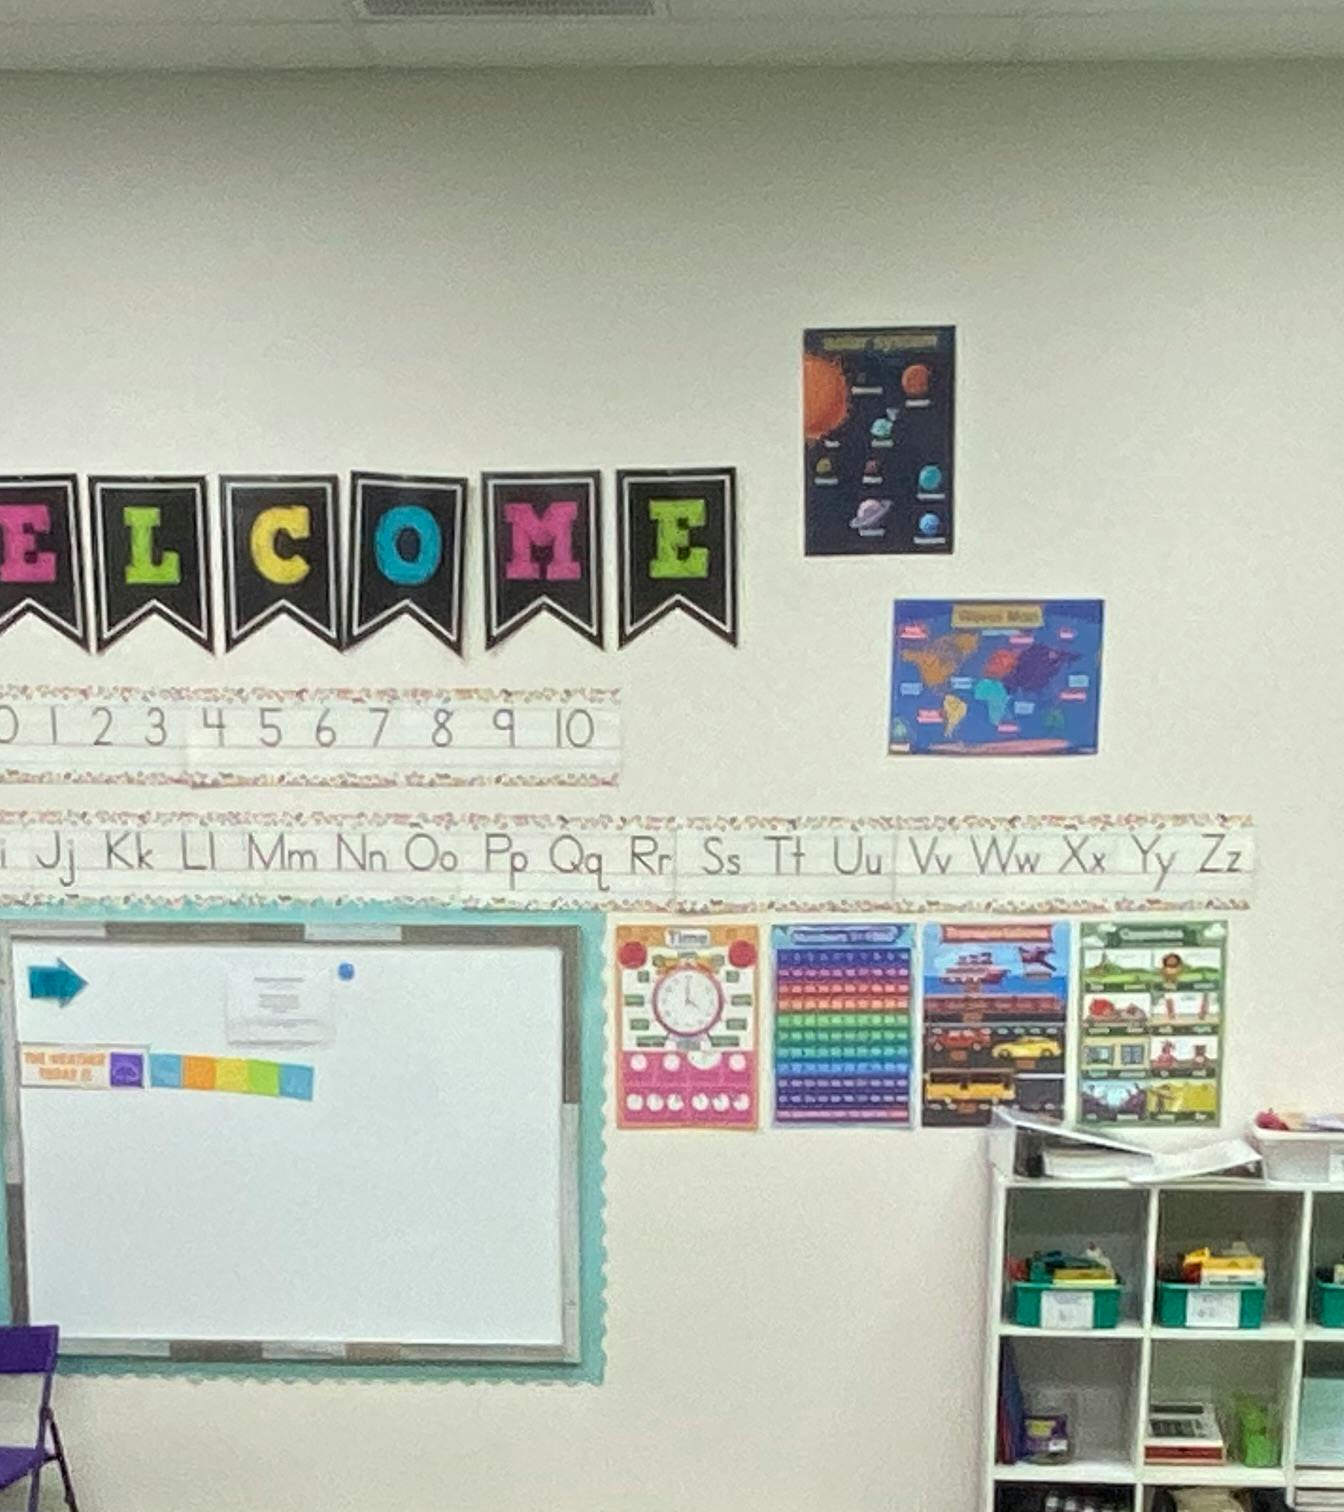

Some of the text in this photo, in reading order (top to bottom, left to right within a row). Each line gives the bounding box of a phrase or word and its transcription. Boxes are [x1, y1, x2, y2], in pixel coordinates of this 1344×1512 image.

[91, 706, 113, 746] 2
[144, 706, 167, 746] 3
[202, 706, 225, 748] 4
[259, 707, 282, 748] 5
[315, 708, 336, 748] 6
[369, 707, 390, 747] 7
[431, 708, 454, 748] 8
[493, 708, 516, 748] 9
[556, 708, 595, 748] 10
[35, 829, 77, 887] Jj
[105, 831, 154, 870] Kk
[181, 831, 216, 870] Ll
[247, 832, 318, 871] Mm
[336, 832, 387, 871] Nn
[404, 832, 458, 871] Oo
[485, 833, 529, 891] Pp
[548, 834, 610, 892] Qq
[629, 835, 672, 875] Rr
[701, 836, 742, 876] Ss
[763, 835, 806, 875] Tt
[833, 836, 882, 875] Uu
[908, 835, 952, 874] Vv
[970, 835, 1041, 874] Ww
[1057, 835, 1106, 873] Xx
[1130, 833, 1177, 892] Yy
[1198, 833, 1242, 873] Zz
